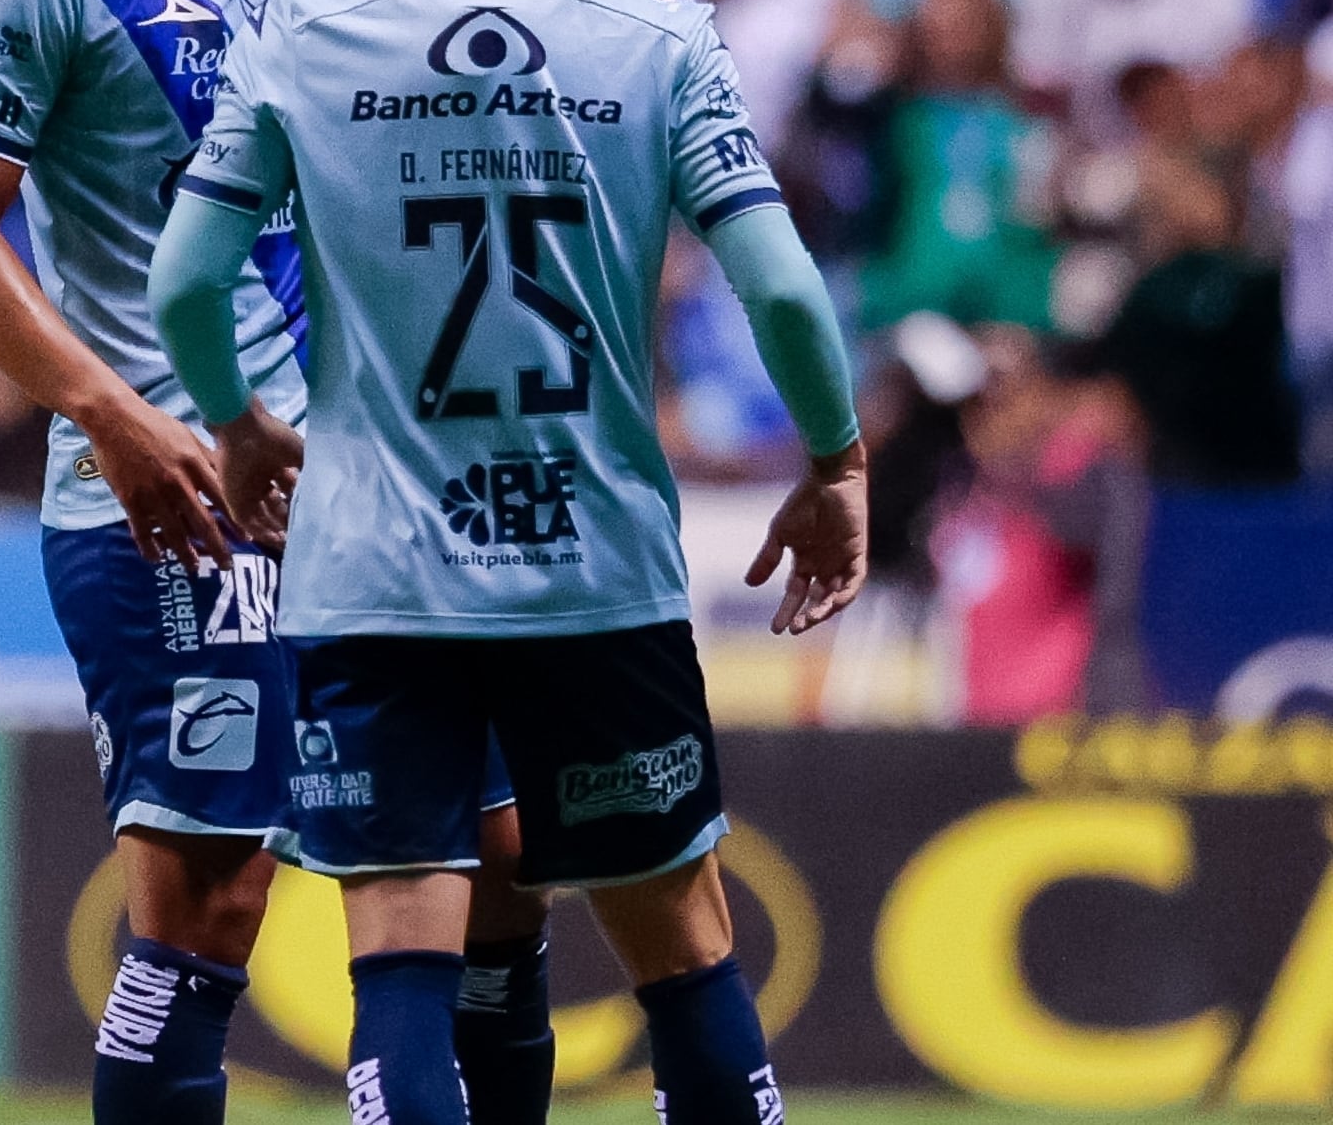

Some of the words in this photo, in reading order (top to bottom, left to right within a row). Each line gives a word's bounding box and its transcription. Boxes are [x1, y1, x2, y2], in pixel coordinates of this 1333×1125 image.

[350, 89, 478, 122] Banco
[484, 83, 623, 124] Azteca
[441, 142, 588, 185] FERNÁNDEZ
[401, 192, 593, 422] 25
[441, 551, 585, 568] visitpuebla.mx
[659, 761, 698, 806] pro
